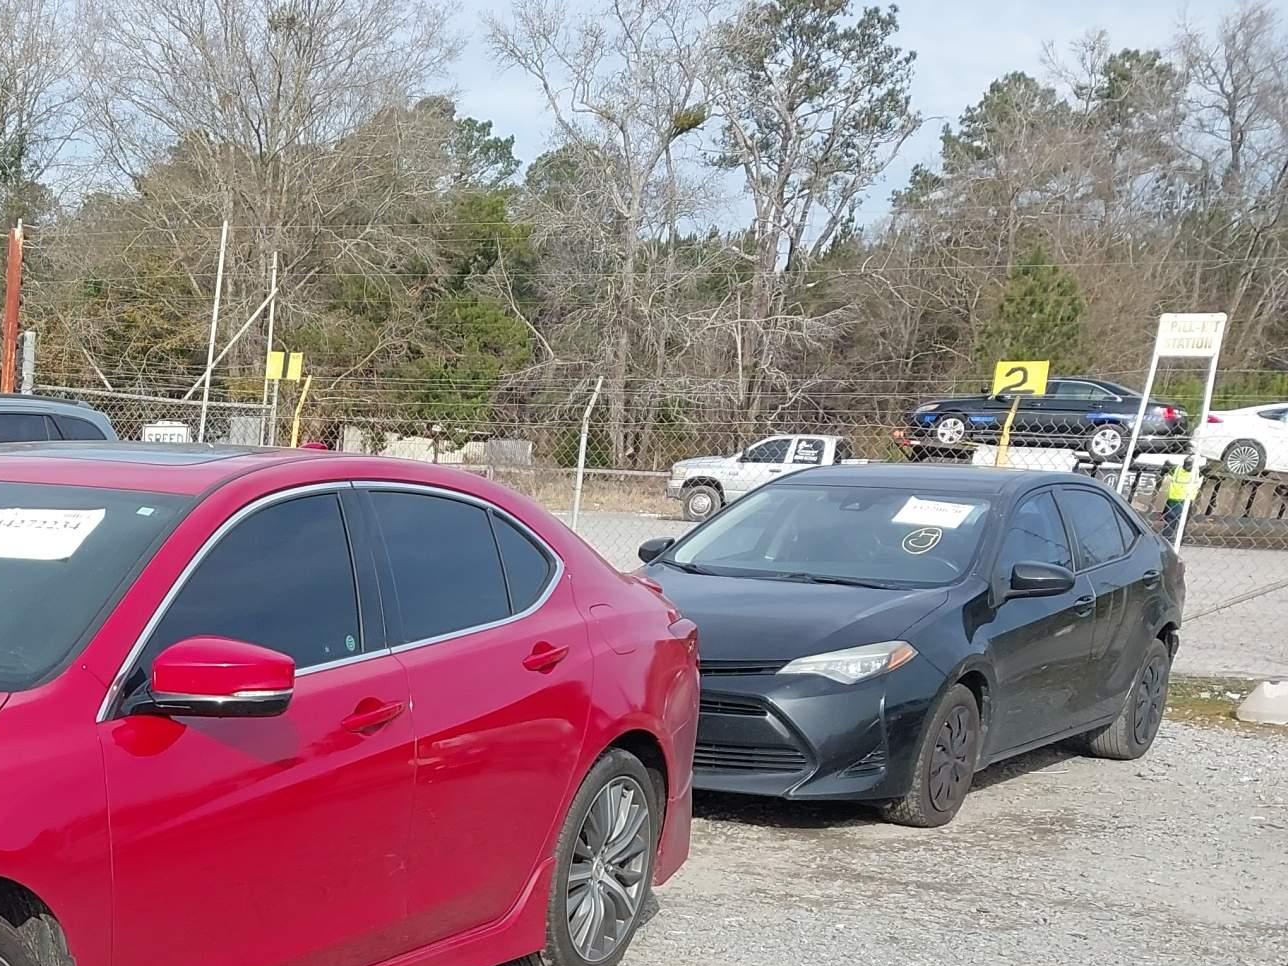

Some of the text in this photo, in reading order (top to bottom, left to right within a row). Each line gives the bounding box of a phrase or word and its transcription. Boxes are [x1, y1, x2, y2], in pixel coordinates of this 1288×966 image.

[1161, 320, 1220, 333] PILL-KT
[1165, 337, 1213, 349] STATION
[998, 366, 1035, 395] 2
[147, 433, 184, 442] SPEED
